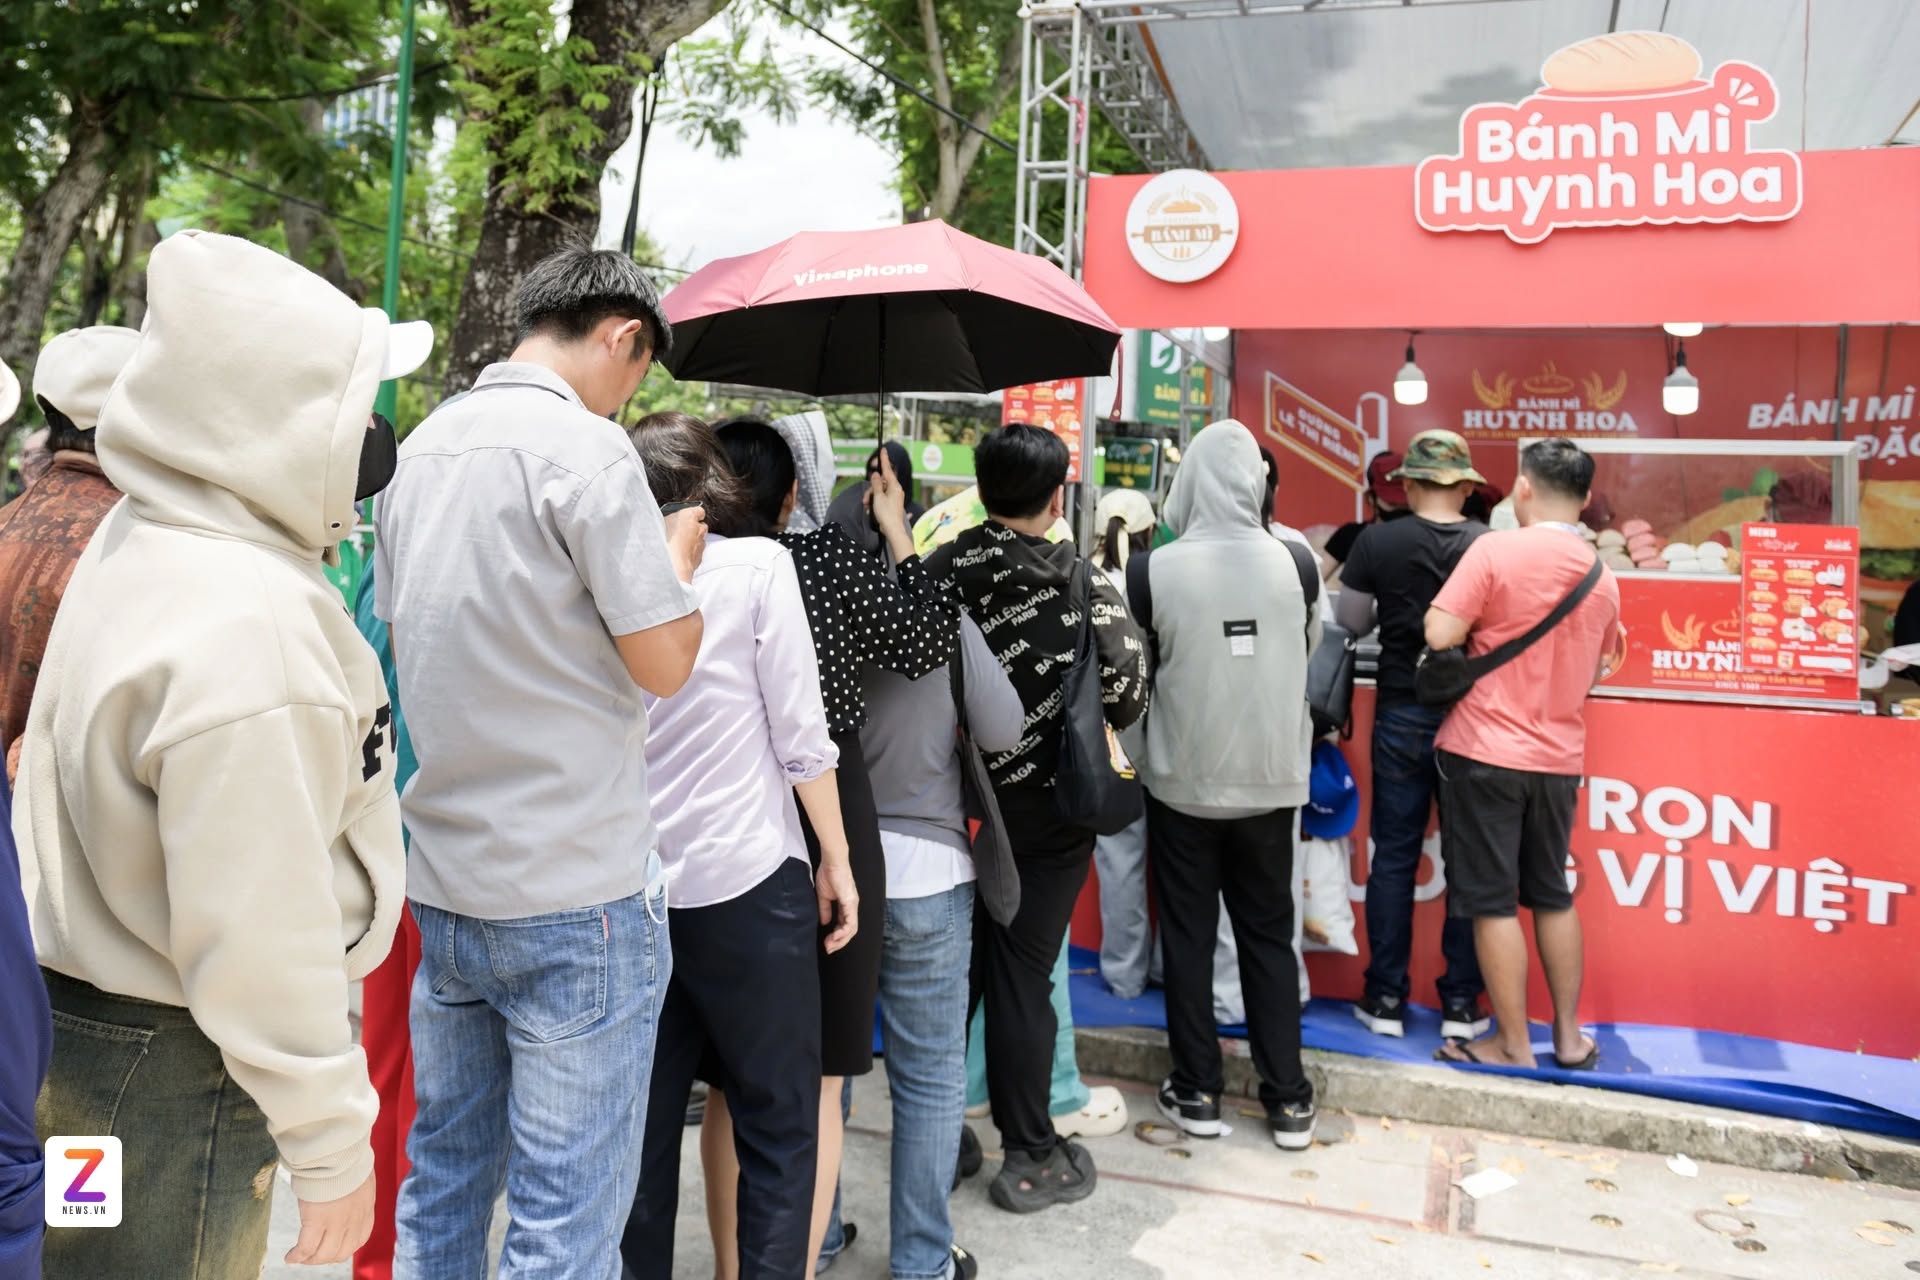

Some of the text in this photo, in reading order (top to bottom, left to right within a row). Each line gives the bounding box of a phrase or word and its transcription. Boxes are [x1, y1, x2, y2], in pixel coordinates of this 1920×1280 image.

[1477, 103, 1732, 163] Bánh Mì
[1433, 161, 1782, 226] Huynh Hoa
[793, 263, 929, 287] Vinaphone
[1462, 410, 1639, 432] HUYNH HOA
[1516, 395, 1560, 410] BÁNH
[1747, 385, 1916, 430] BÁNH MÌ
[980, 586, 1061, 635] BALENCIAGA
[1010, 607, 1039, 627] PARIS
[1579, 776, 1772, 853] RỌN
[1597, 848, 1684, 924] VỊ
[1707, 857, 1908, 933] VIỆT
